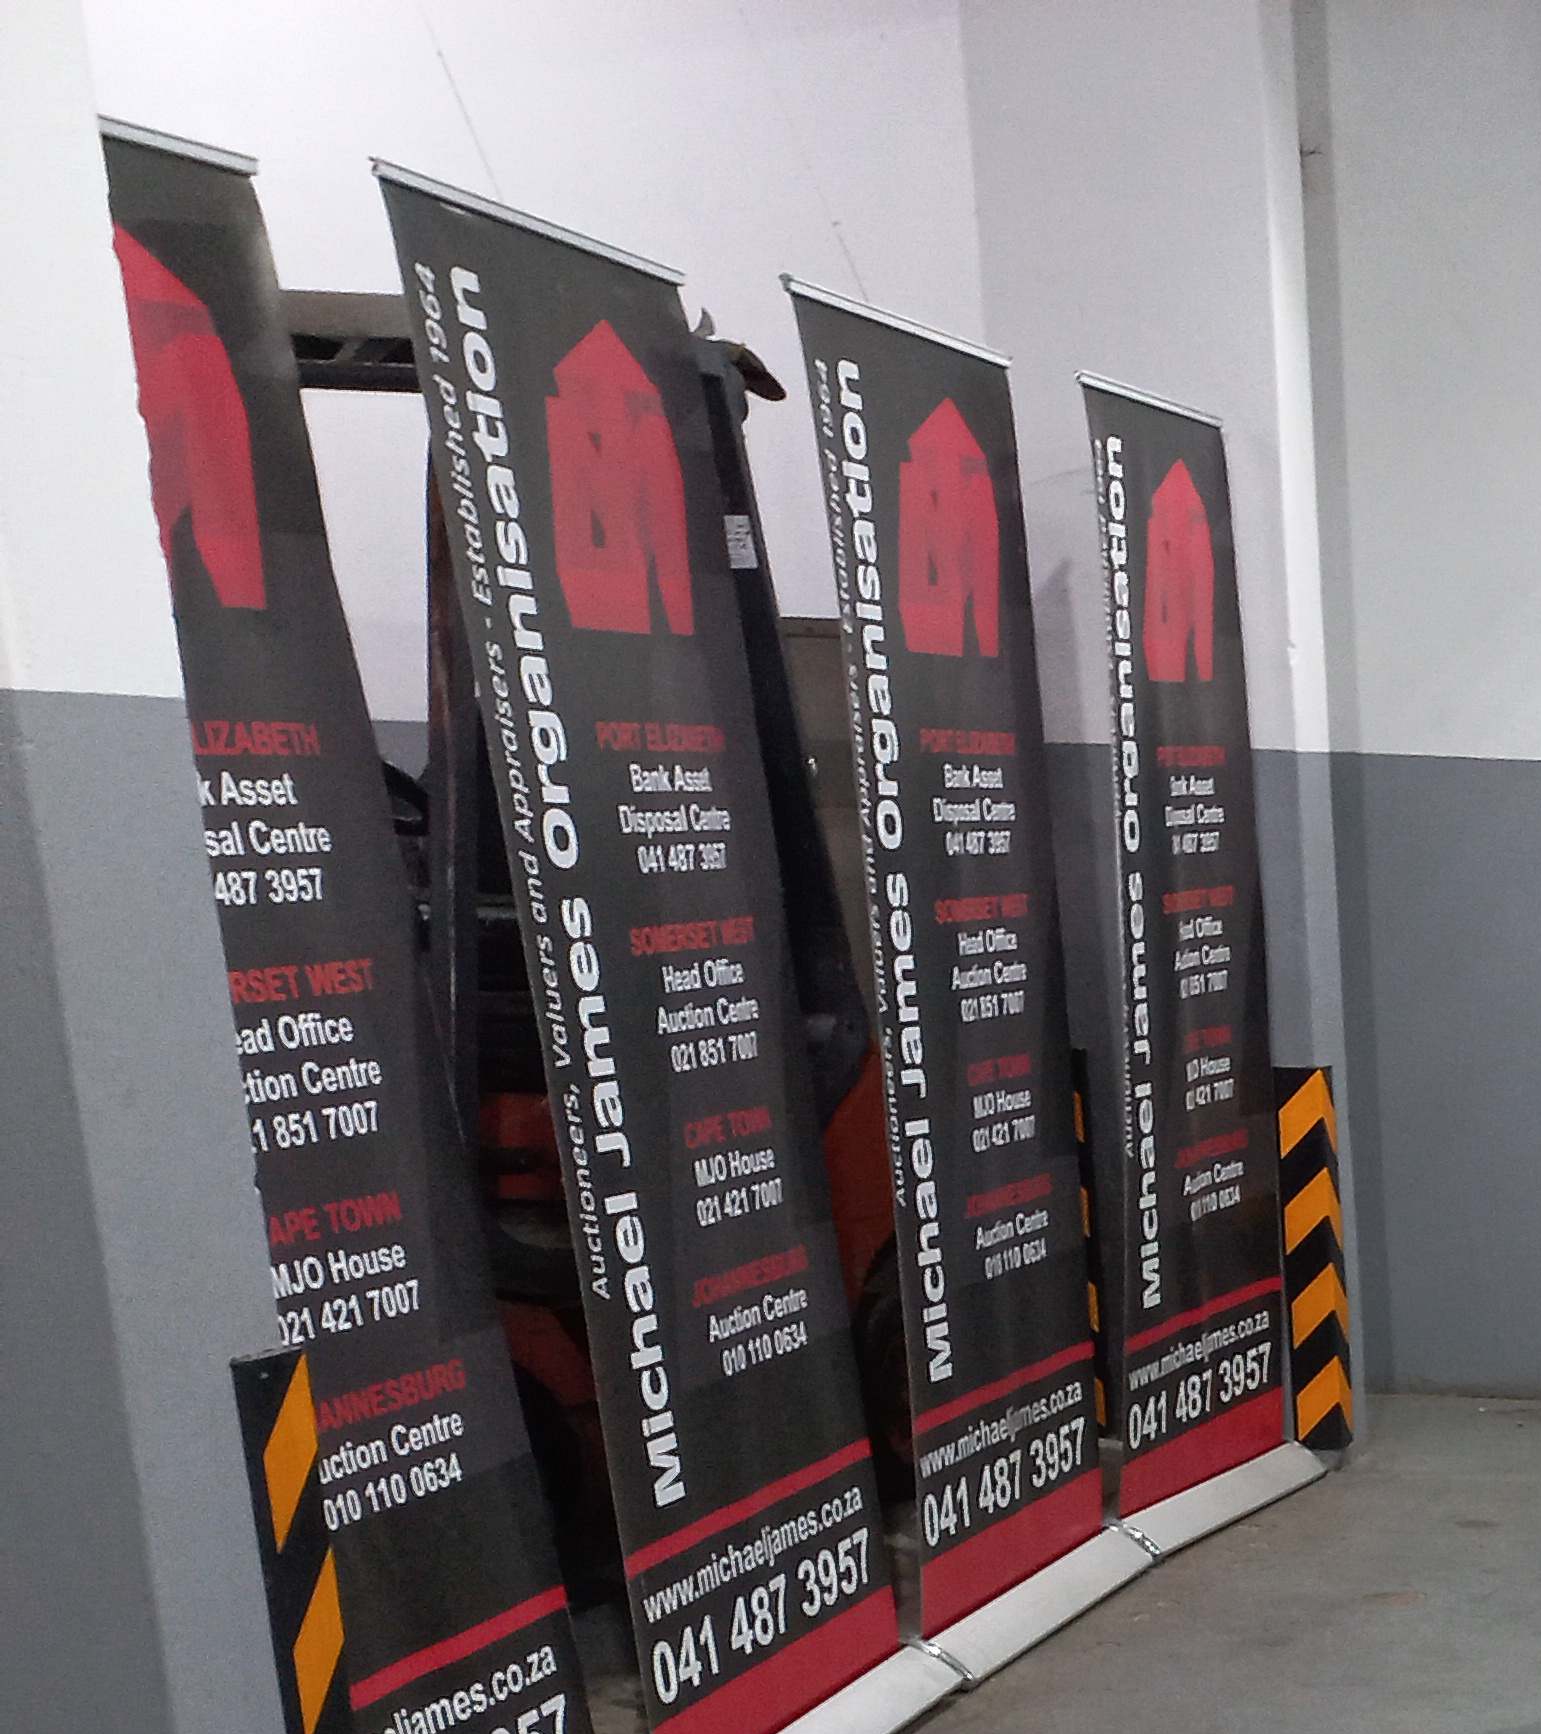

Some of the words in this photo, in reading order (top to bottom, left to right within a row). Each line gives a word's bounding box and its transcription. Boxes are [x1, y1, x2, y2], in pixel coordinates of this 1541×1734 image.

[415, 261, 450, 364] 1964
[432, 374, 494, 606] Established
[450, 266, 579, 869] Organisation
[836, 359, 903, 850] Organisation
[1106, 436, 1142, 853] Organisation
[485, 640, 534, 844] Appraisers
[221, 771, 299, 806] Asset
[629, 763, 672, 792] Bank
[249, 820, 332, 854] Centre
[617, 804, 689, 839] Disposal
[668, 843, 696, 872] 487
[214, 871, 257, 906] 487
[265, 868, 323, 904] 3957
[518, 849, 547, 924] and
[304, 958, 374, 997] WEST
[535, 933, 572, 1068] Valuers
[661, 962, 702, 993] Head
[703, 958, 745, 988] Office
[886, 872, 926, 1099] James
[277, 1012, 354, 1049] Office
[561, 897, 631, 1168] James
[658, 1002, 715, 1035] Auction
[716, 996, 760, 1025] Centre
[301, 1058, 383, 1094] Centre
[671, 1042, 698, 1073] 021
[699, 1037, 727, 1068] 851
[273, 1110, 319, 1148] 851
[321, 1100, 378, 1139] 7007
[563, 1083, 611, 1300] Auctioneers,
[728, 1149, 776, 1179] House
[324, 1190, 402, 1234] TOWN
[696, 1194, 723, 1227] 021
[724, 1187, 750, 1218] 421
[1134, 1082, 1162, 1310] Michael
[271, 1256, 325, 1299] MJO
[327, 1243, 406, 1284] House
[904, 1118, 953, 1383] Michael
[321, 1294, 364, 1333] 421
[366, 1280, 419, 1321] 7007
[708, 1305, 762, 1343] Auction
[763, 1288, 808, 1322] Centre
[604, 1191, 687, 1507] Michael
[721, 1344, 747, 1377] 010
[748, 1333, 772, 1365] 110
[773, 1320, 808, 1355] 0634
[1129, 1390, 1167, 1450] 041
[1175, 1368, 1213, 1423] 487
[1218, 1341, 1272, 1403] 3957
[391, 1413, 464, 1456] Centre
[323, 1488, 363, 1531] 010
[366, 1473, 408, 1512] 110
[410, 1453, 463, 1502] 0634
[923, 1475, 971, 1547] 041
[978, 1448, 1022, 1514] 487
[1029, 1415, 1086, 1488] 3957
[643, 1486, 863, 1624] www.michaeljames.co.za
[652, 1614, 720, 1704] 041
[730, 1572, 787, 1656] 487
[797, 1527, 869, 1617] 3957
